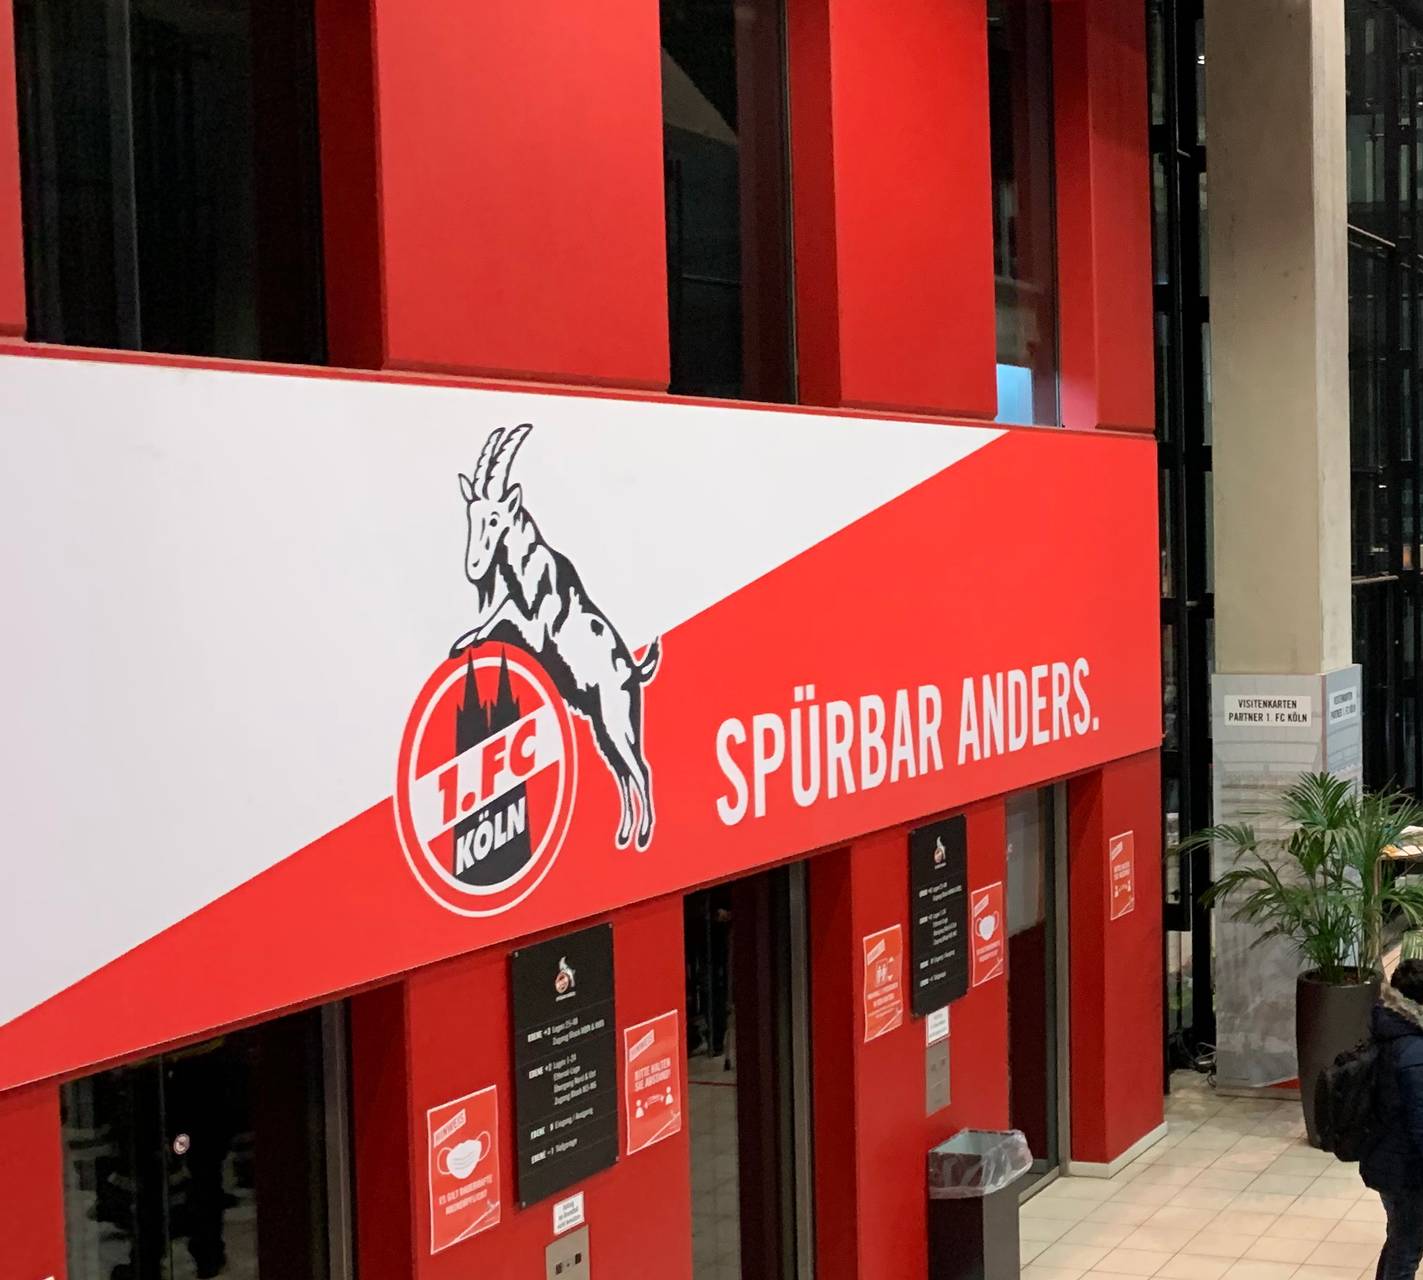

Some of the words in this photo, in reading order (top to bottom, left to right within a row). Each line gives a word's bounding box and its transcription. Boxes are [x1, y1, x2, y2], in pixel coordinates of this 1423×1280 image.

[1228, 712, 1263, 722] PARTNER
[1275, 712, 1285, 722] FC
[1287, 711, 1308, 723] KÖLN
[1238, 699, 1297, 709] VISITENKARTEN
[715, 683, 944, 827] SPÜRBAR
[957, 656, 1100, 767] ANDERS.
[456, 795, 527, 877] KÖLN
